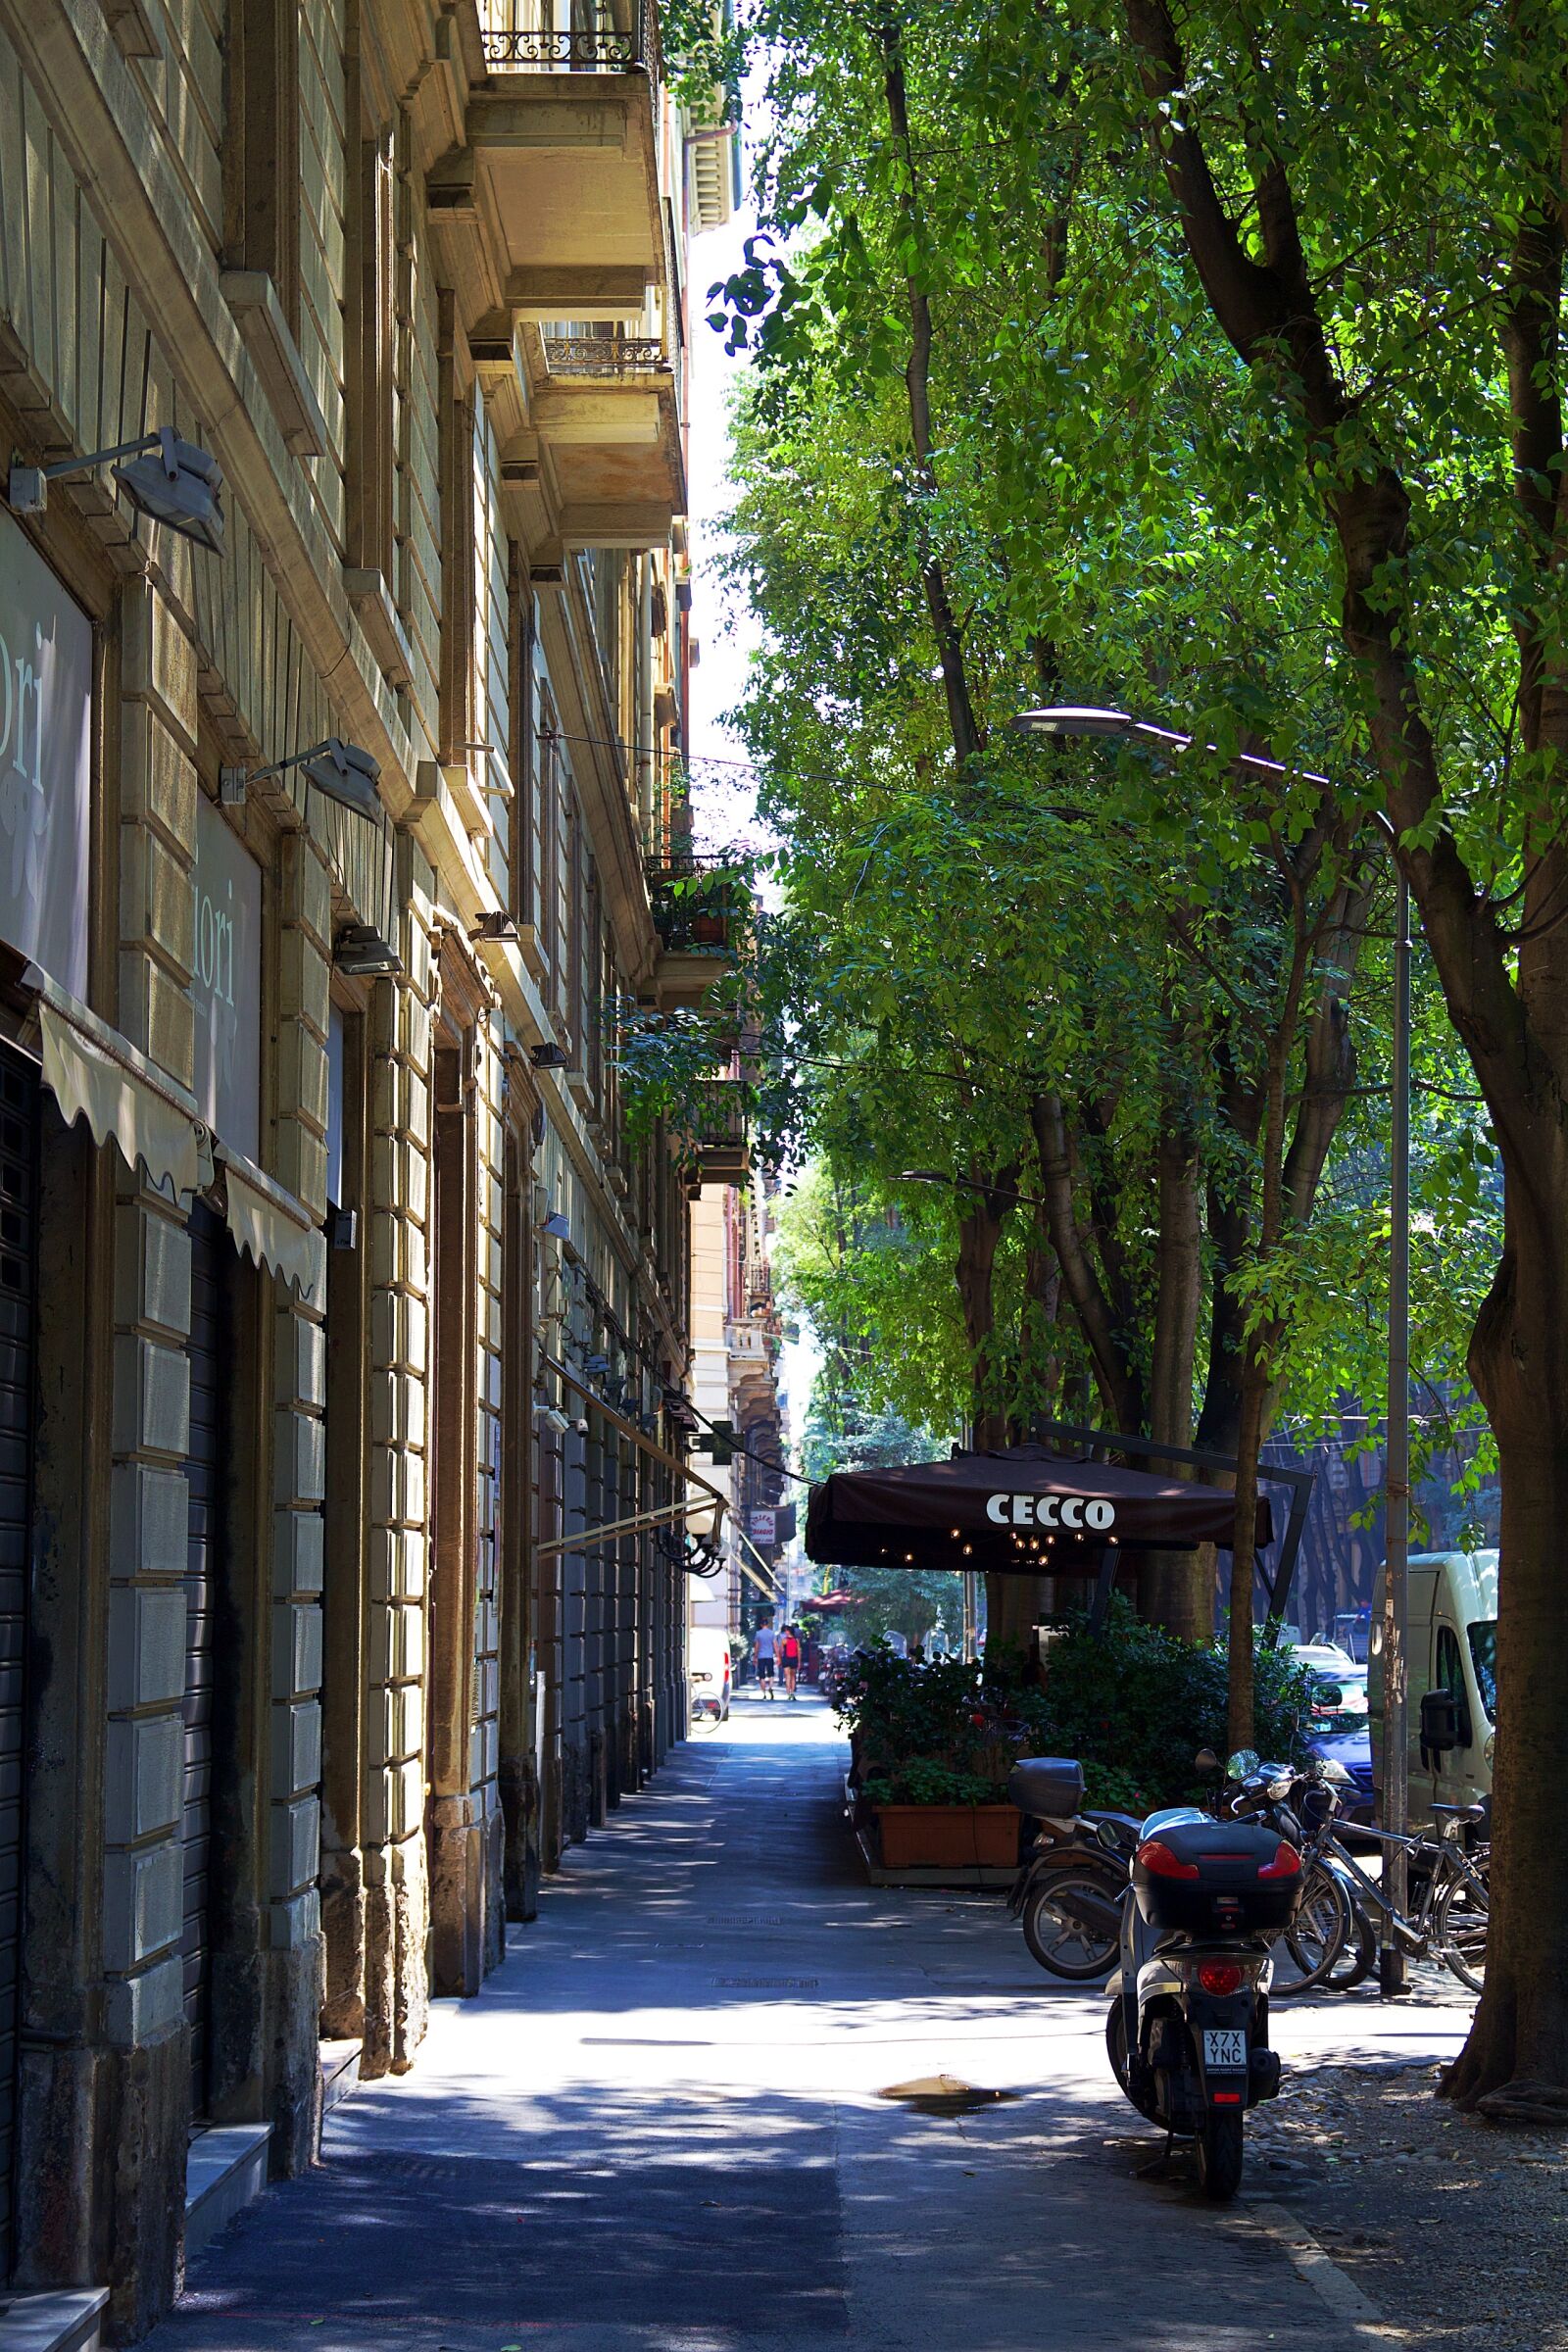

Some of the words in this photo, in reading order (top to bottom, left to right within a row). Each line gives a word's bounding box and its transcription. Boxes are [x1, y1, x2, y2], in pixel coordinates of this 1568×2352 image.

[986, 1494, 1115, 1530] CECCO
[1209, 2033, 1241, 2047] X7X
[1210, 2048, 1241, 2063] YNC
